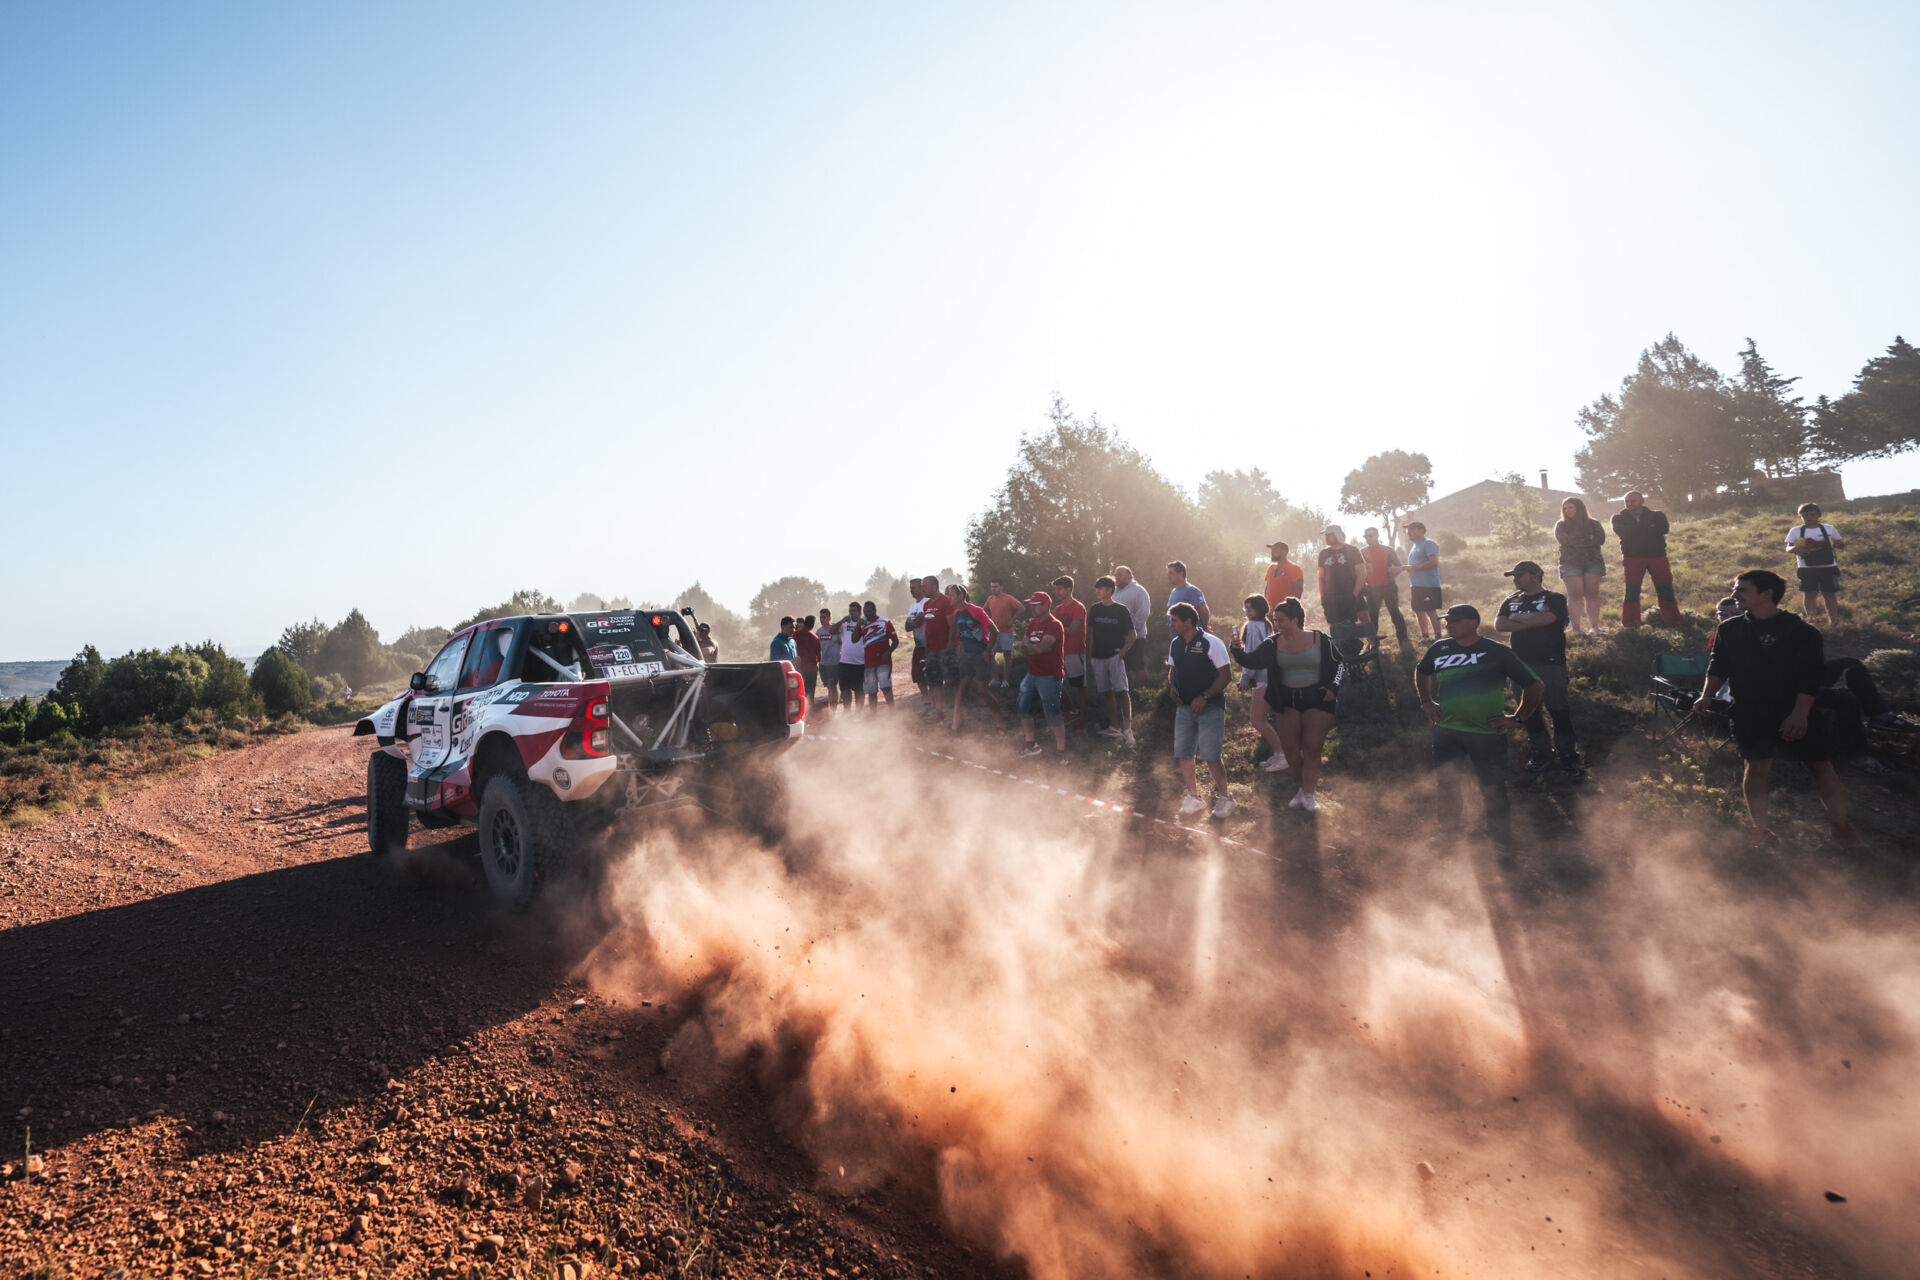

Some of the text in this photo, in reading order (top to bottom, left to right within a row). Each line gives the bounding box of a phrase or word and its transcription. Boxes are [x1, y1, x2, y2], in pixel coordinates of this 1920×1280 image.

[587, 620, 609, 628] GR
[615, 650, 630, 660] 220
[1433, 652, 1487, 671] FOX
[540, 688, 570, 698] TOYOTA
